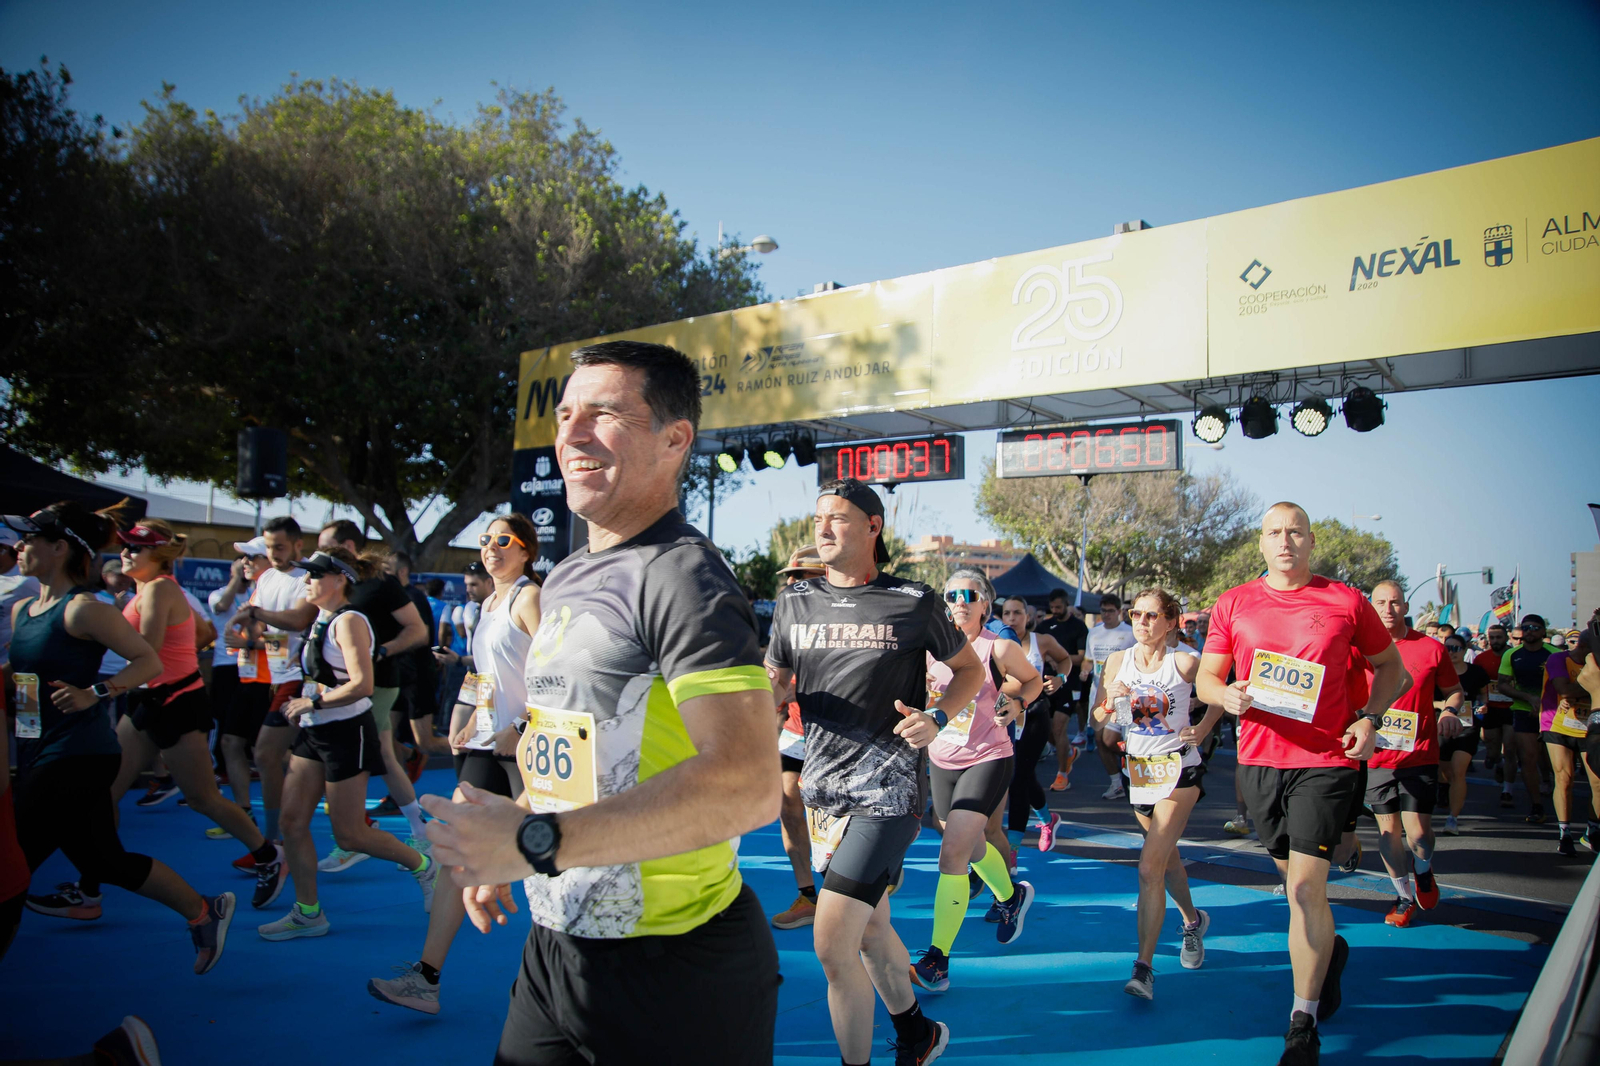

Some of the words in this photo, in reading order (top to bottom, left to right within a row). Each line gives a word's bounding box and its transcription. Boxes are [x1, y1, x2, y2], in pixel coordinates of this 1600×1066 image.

[1238, 284, 1327, 306] COOPERACIÓN
[1357, 281, 1379, 291] 2020
[1011, 251, 1124, 352] 25
[1238, 304, 1268, 317] 2005
[691, 352, 727, 371] atón
[700, 373, 727, 397] 24
[737, 376, 782, 393] RAMÓN
[787, 371, 818, 386] RUIZ
[823, 361, 890, 382] ANDÚJAR
[837, 439, 950, 481] 00:00:37
[521, 477, 563, 495] cajamar
[828, 624, 898, 642] TRAIL
[828, 640, 847, 649] DEL
[850, 640, 899, 650] ESPARTO
[1259, 661, 1315, 690] 2003
[1383, 715, 1412, 731] 942
[526, 731, 573, 780] 686
[1134, 762, 1178, 779] 1486
